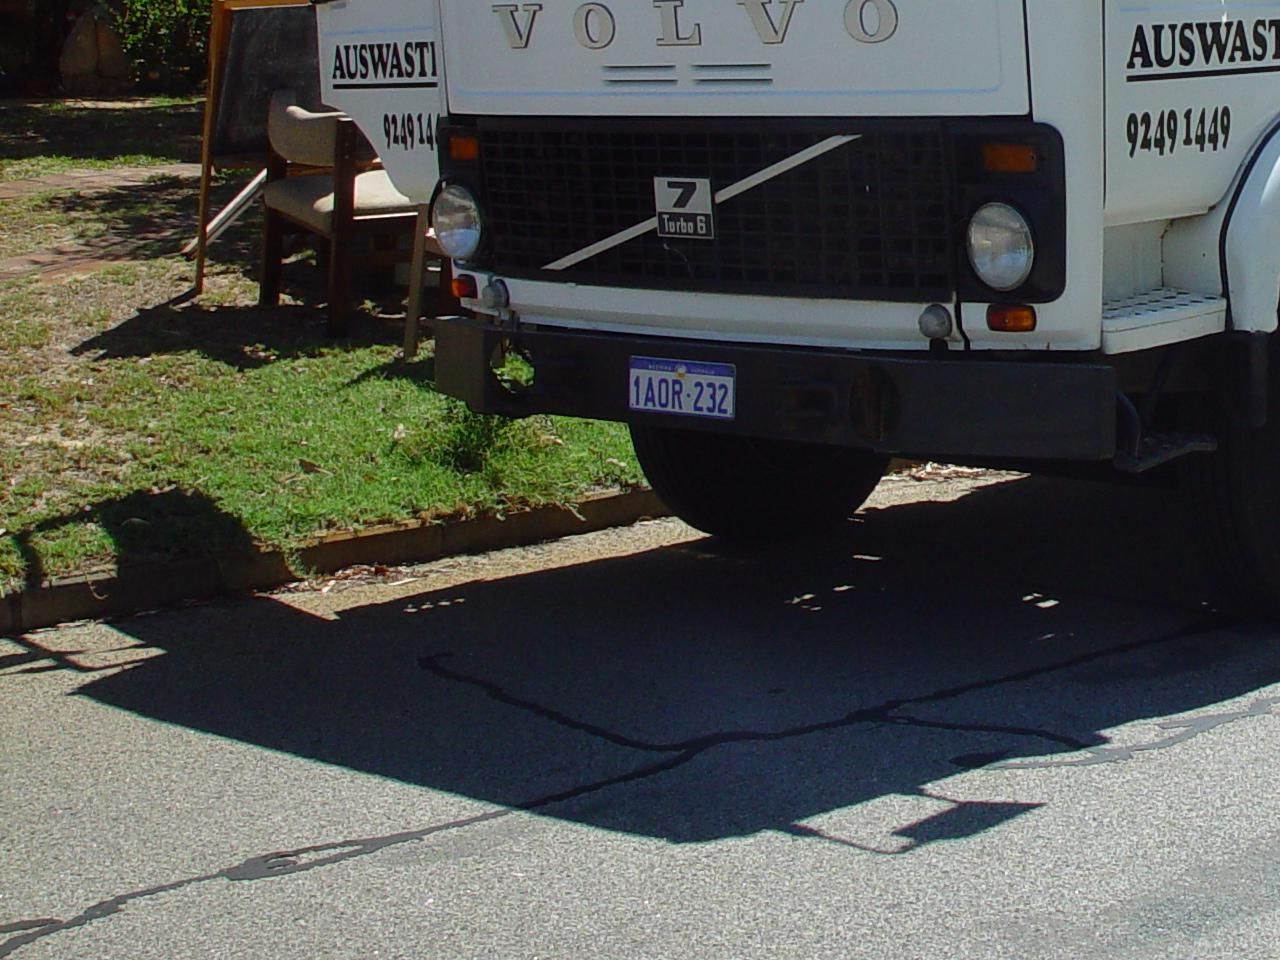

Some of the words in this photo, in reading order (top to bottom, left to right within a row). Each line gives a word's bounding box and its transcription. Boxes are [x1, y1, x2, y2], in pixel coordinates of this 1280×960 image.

[1126, 108, 1178, 158] 9249
[1182, 105, 1231, 152] 1449
[667, 181, 697, 208] 7
[662, 214, 694, 234] Turbo
[697, 215, 707, 234] 6
